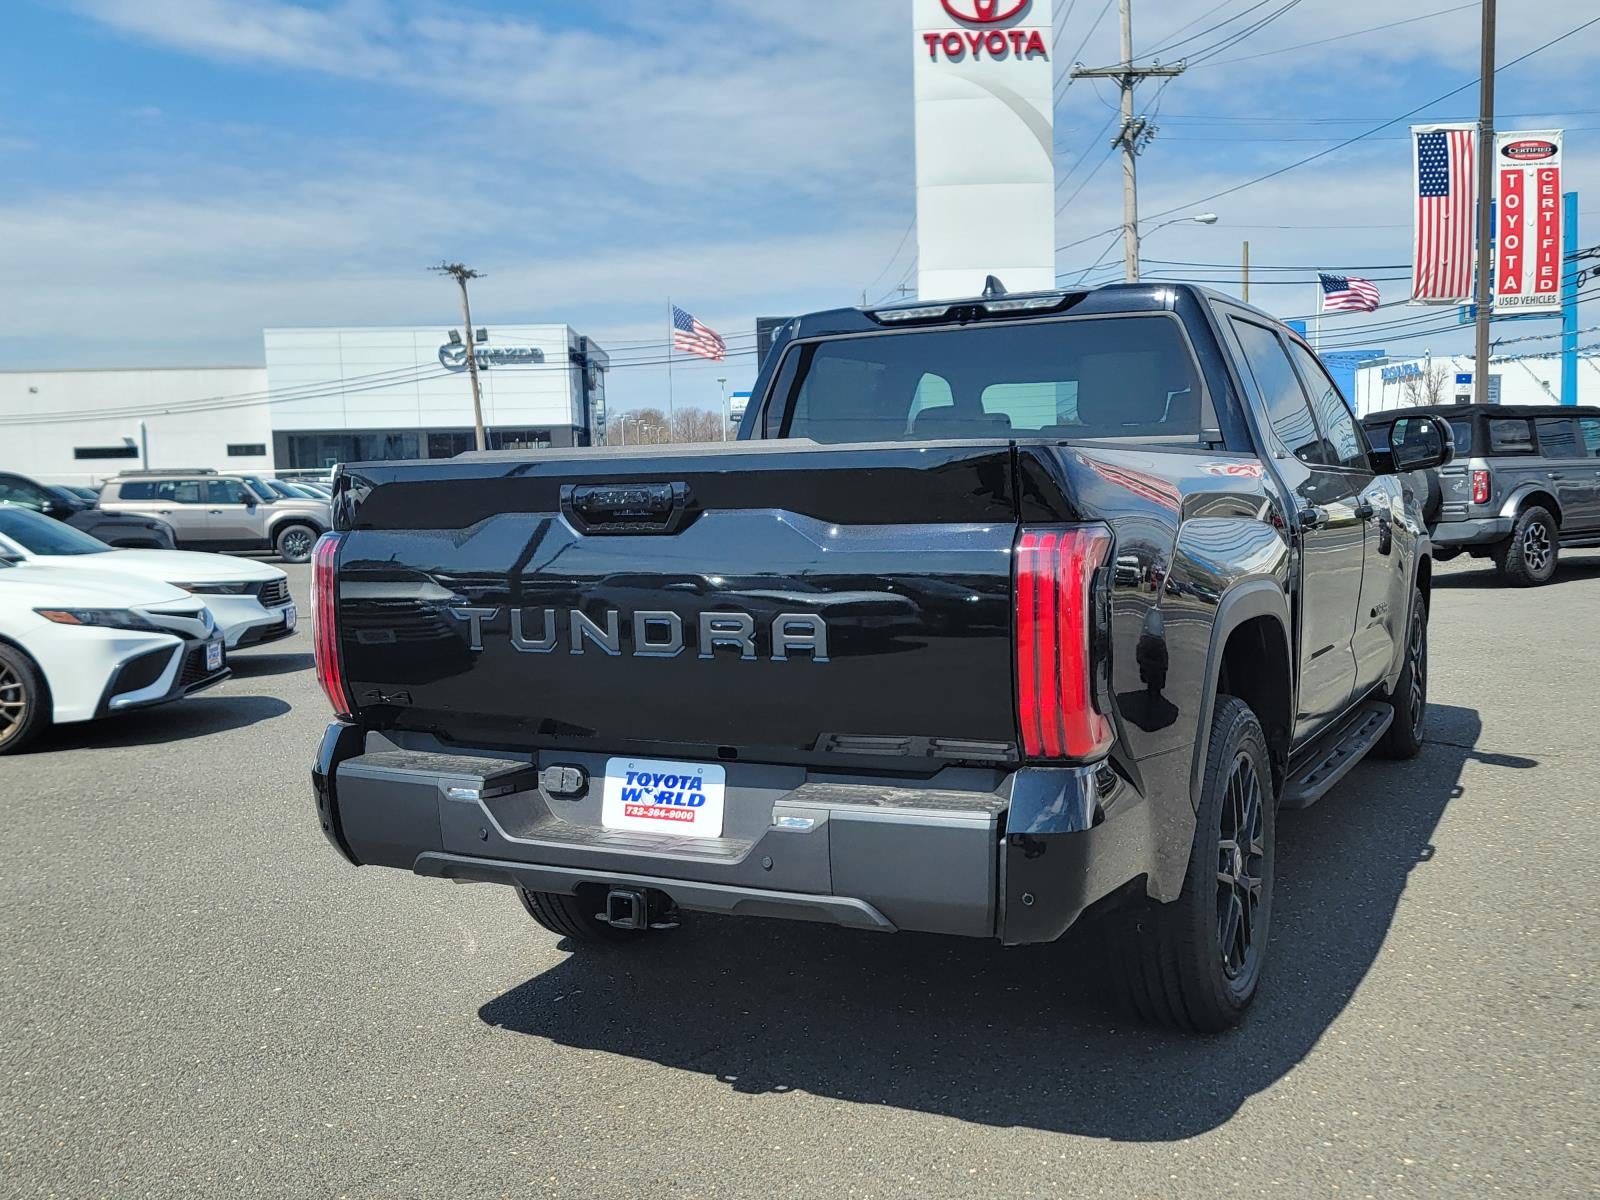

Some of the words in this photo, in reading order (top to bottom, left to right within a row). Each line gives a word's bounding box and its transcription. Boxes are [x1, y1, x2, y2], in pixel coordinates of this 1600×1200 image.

[922, 30, 1047, 58] TOYOTA
[1502, 173, 1519, 290] TOYOTA
[1539, 171, 1554, 290] CERTIFIED
[1499, 296, 1519, 306] USED
[1520, 294, 1557, 305] VEHICLES
[447, 607, 831, 663] TUNDRA
[625, 771, 702, 791] TOYOTA
[621, 787, 706, 807] WORLD
